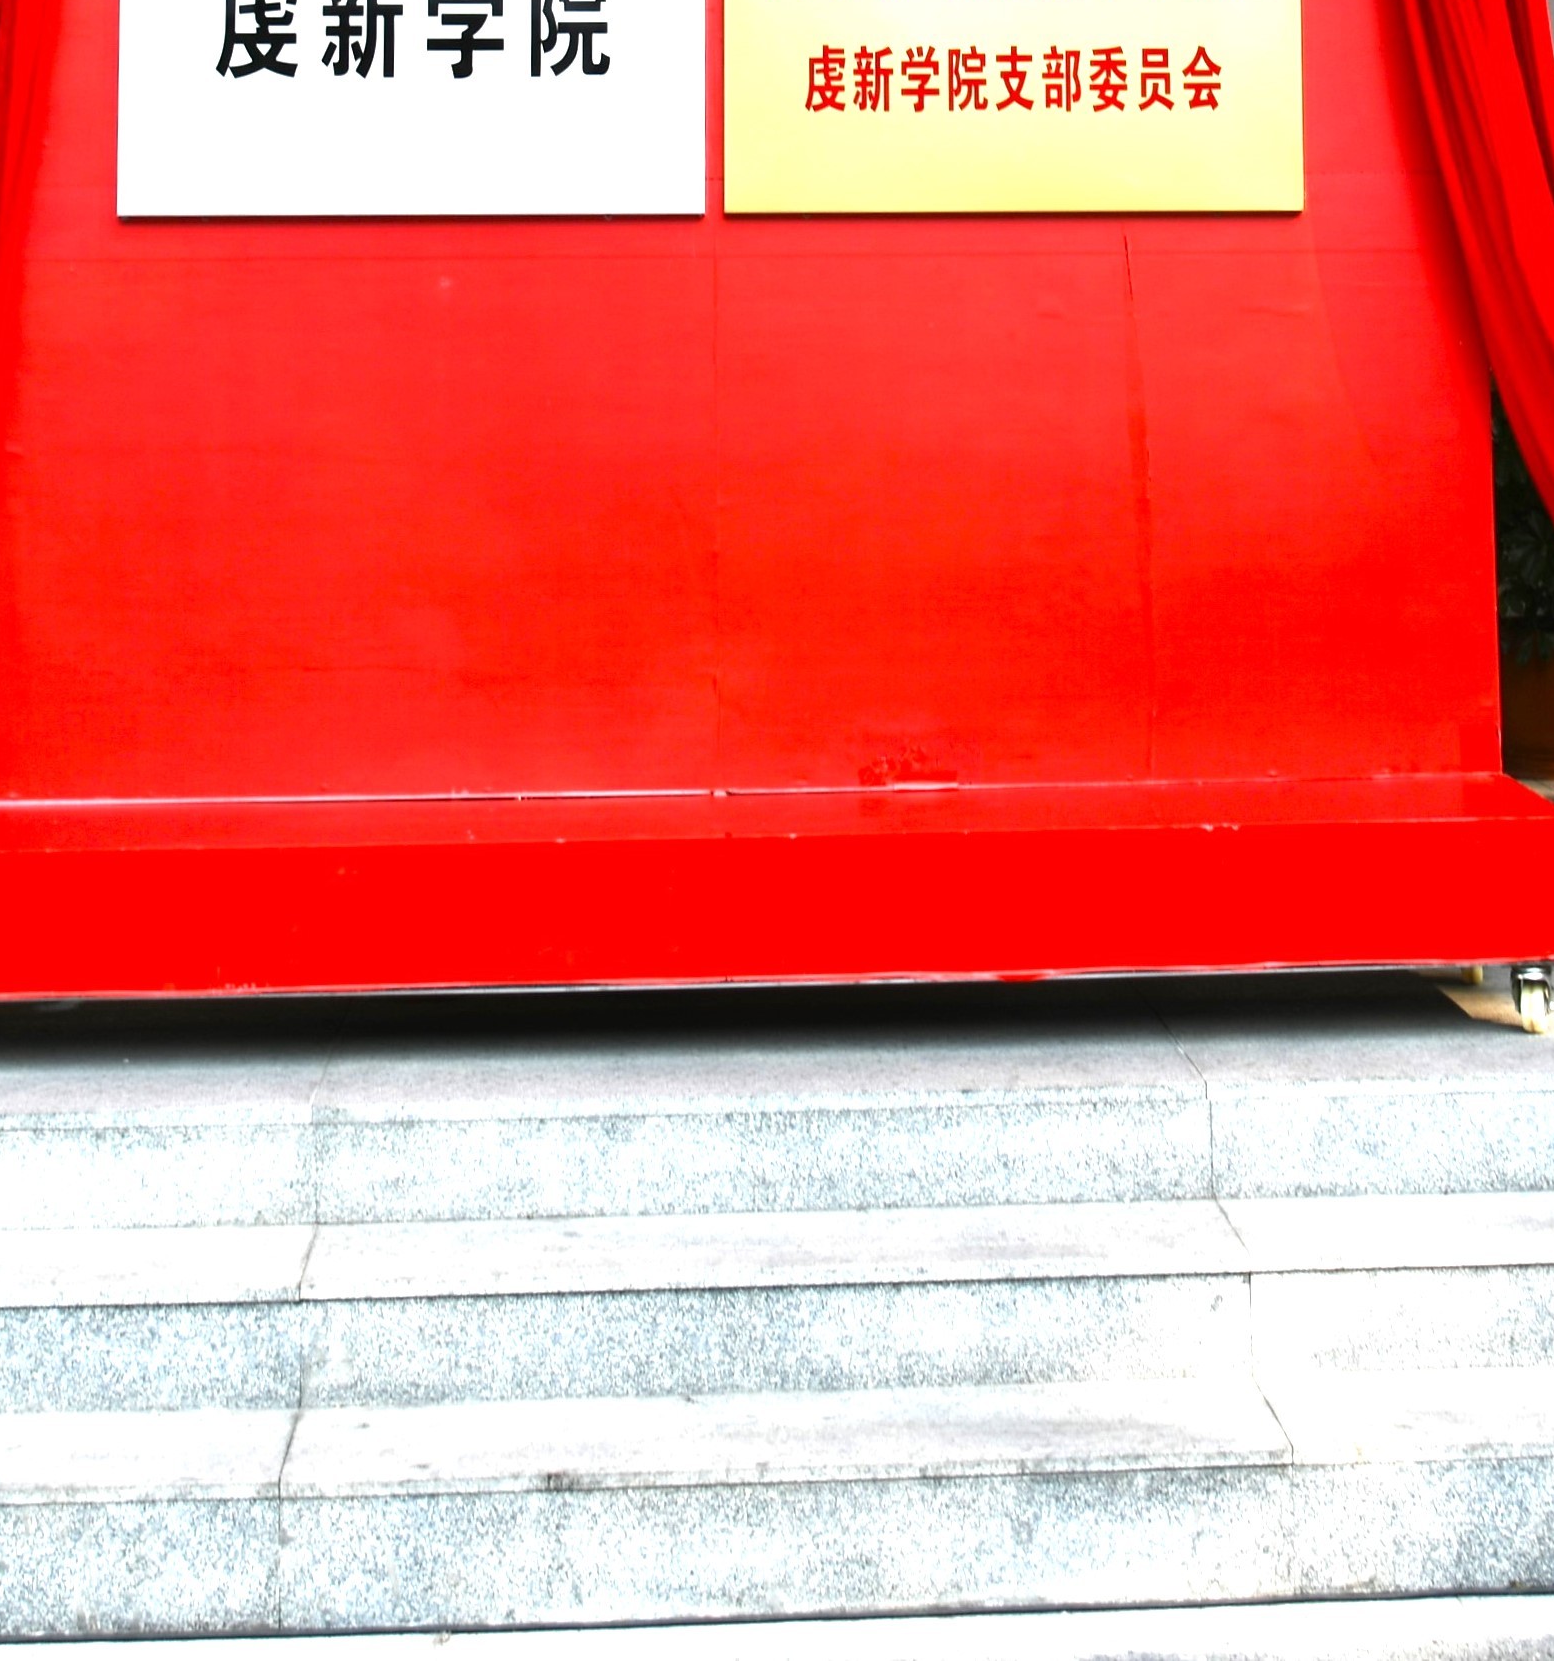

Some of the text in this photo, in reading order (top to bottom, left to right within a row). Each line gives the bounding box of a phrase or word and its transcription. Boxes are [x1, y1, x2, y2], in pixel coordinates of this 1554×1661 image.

[804, 44, 1223, 113] 虔新学院支部委员会
